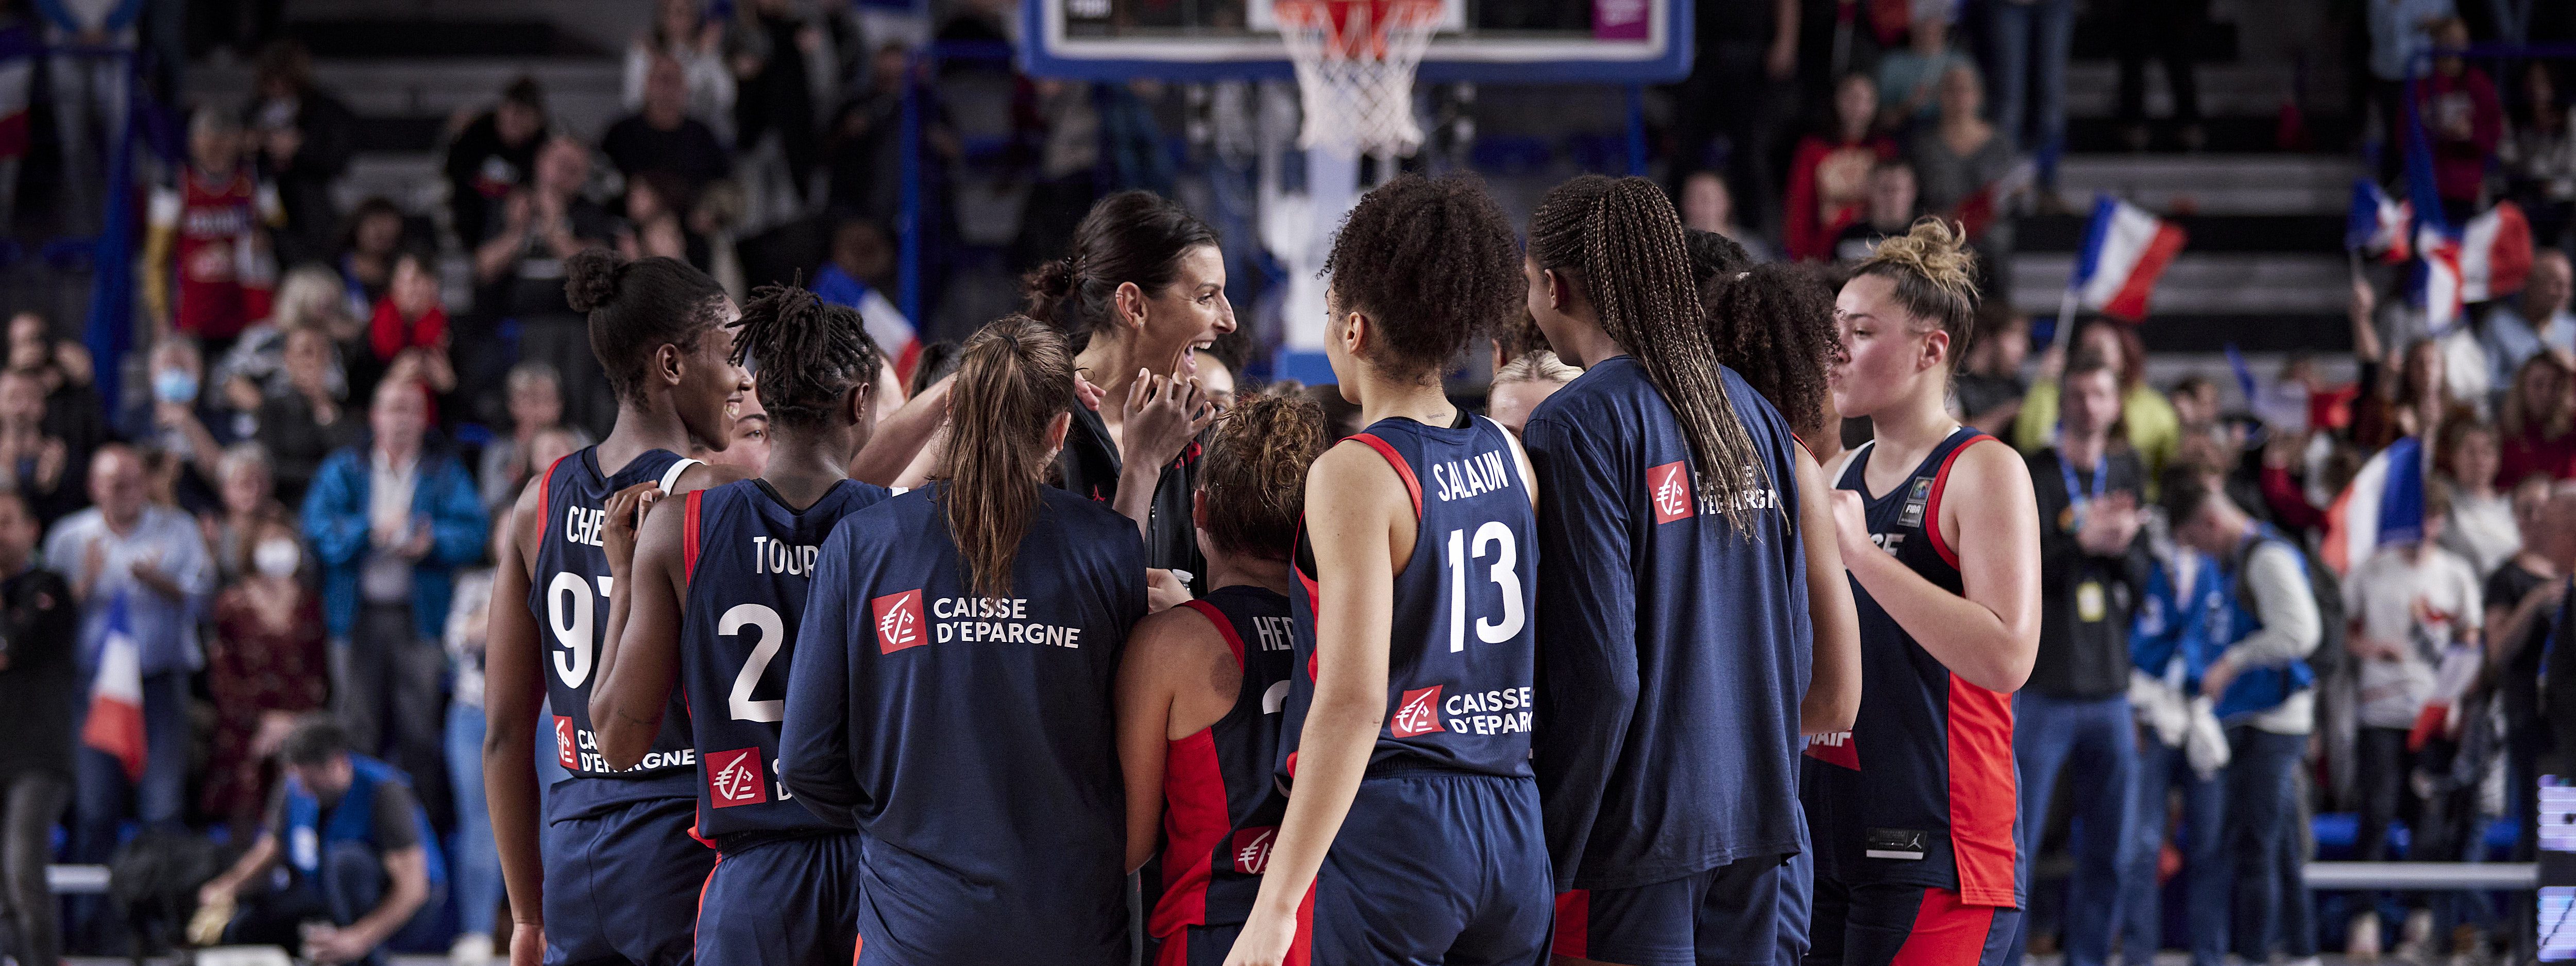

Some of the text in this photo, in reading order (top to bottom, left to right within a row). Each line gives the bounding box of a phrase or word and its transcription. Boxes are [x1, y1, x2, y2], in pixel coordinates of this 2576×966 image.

[1433, 450, 1509, 502] SALAUN
[1905, 504, 1921, 515] FIBA
[1448, 521, 1525, 653] 13
[934, 597, 1027, 619] CAISSE
[936, 621, 1081, 649] D'EPARGNE
[718, 603, 784, 722] 2
[1446, 687, 1531, 715] CAISSE
[578, 729, 597, 750] CA
